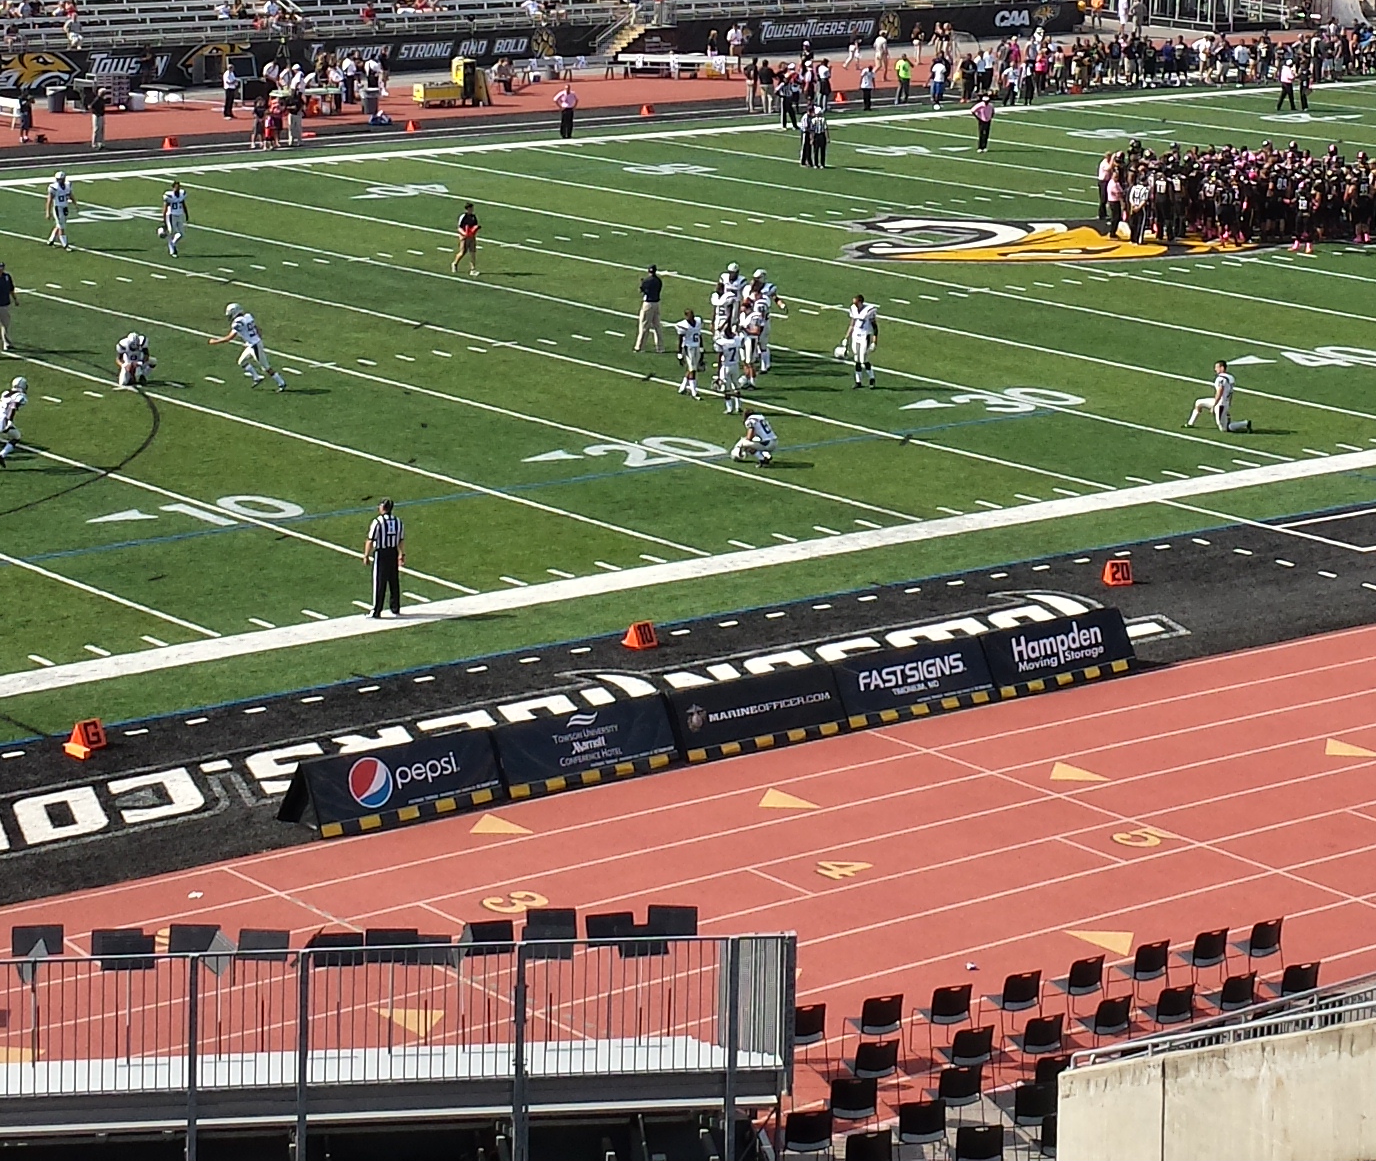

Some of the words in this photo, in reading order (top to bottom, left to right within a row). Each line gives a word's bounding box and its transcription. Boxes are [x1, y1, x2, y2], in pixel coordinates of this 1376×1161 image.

[994, 10, 1030, 27] CAA
[398, 41, 452, 59] STRONG
[460, 40, 487, 55] AND
[493, 37, 529, 54] BOLD
[90, 53, 169, 78] TOWSN
[950, 387, 1087, 414] 30
[582, 436, 728, 468] 20
[158, 493, 306, 527] 10
[1110, 562, 1131, 582] 20
[636, 622, 654, 645] 10
[1011, 621, 1102, 664] Hampden
[858, 652, 965, 691] FASTSIGNS
[1018, 655, 1058, 673] Moving
[1065, 645, 1105, 662] Storage
[708, 691, 831, 723] MARINEOFFICER.COM
[83, 721, 102, 746] G
[571, 736, 607, 755] Marriott
[395, 751, 455, 790] pepsi
[1112, 826, 1172, 849] 5
[816, 860, 874, 880] 4
[481, 890, 549, 914] 3
